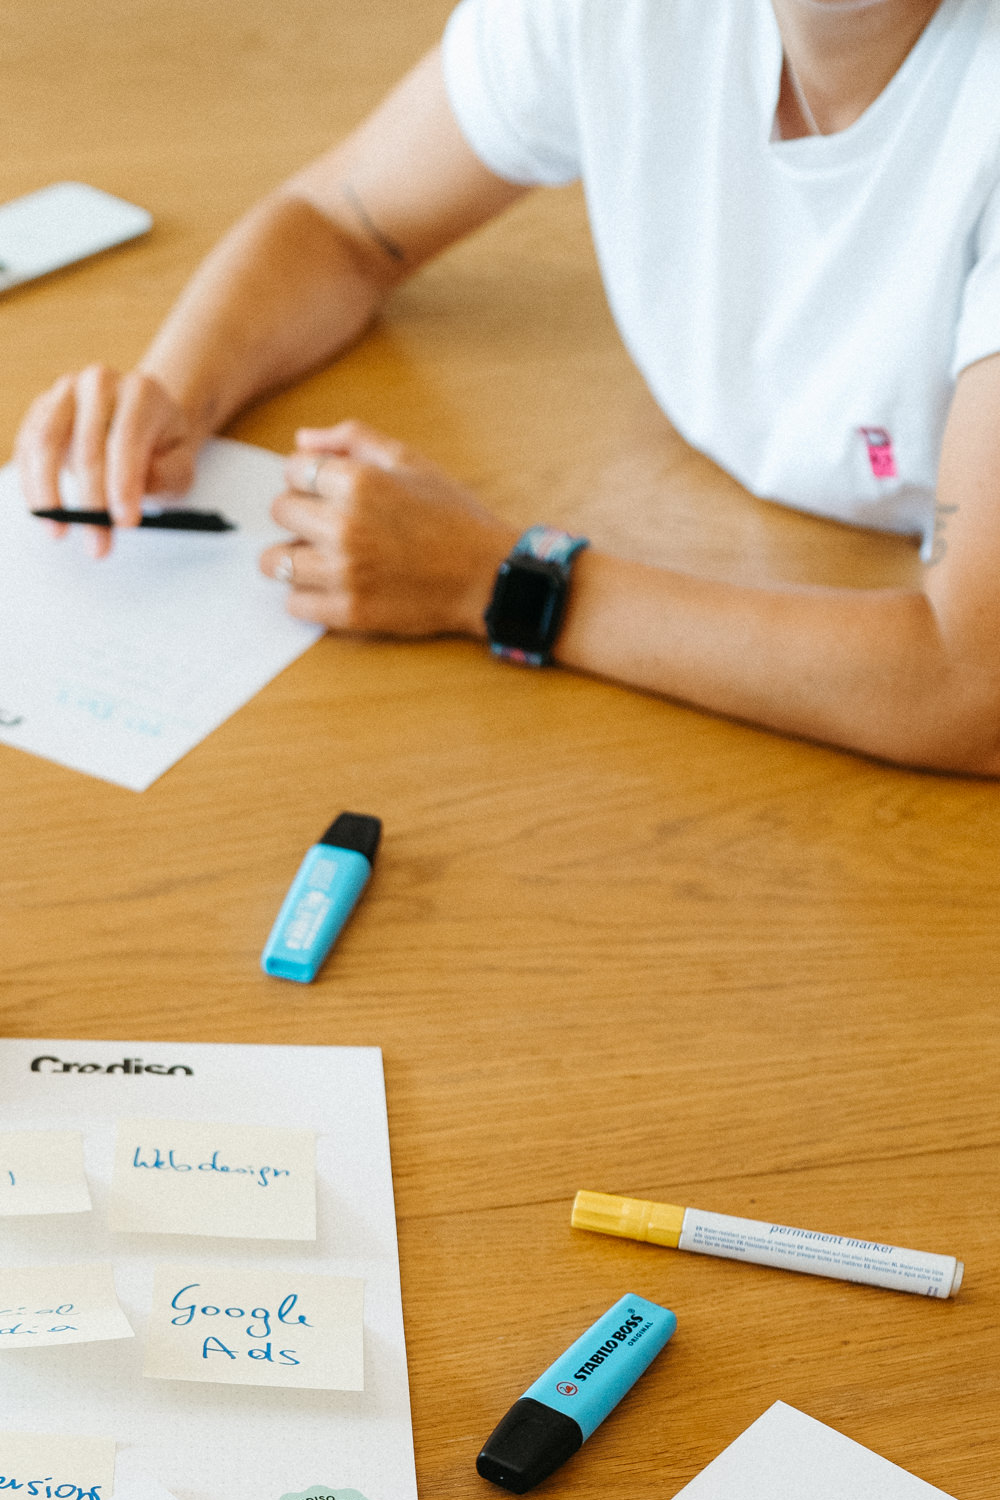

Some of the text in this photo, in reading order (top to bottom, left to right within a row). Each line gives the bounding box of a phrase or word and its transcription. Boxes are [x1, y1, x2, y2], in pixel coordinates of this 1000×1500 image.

[769, 1225, 896, 1255] permanent marker
[171, 1283, 315, 1338] Google
[627, 1321, 654, 1347] ORIGINAL
[202, 1336, 301, 1366] Ads
[573, 1339, 619, 1382] STABILO
